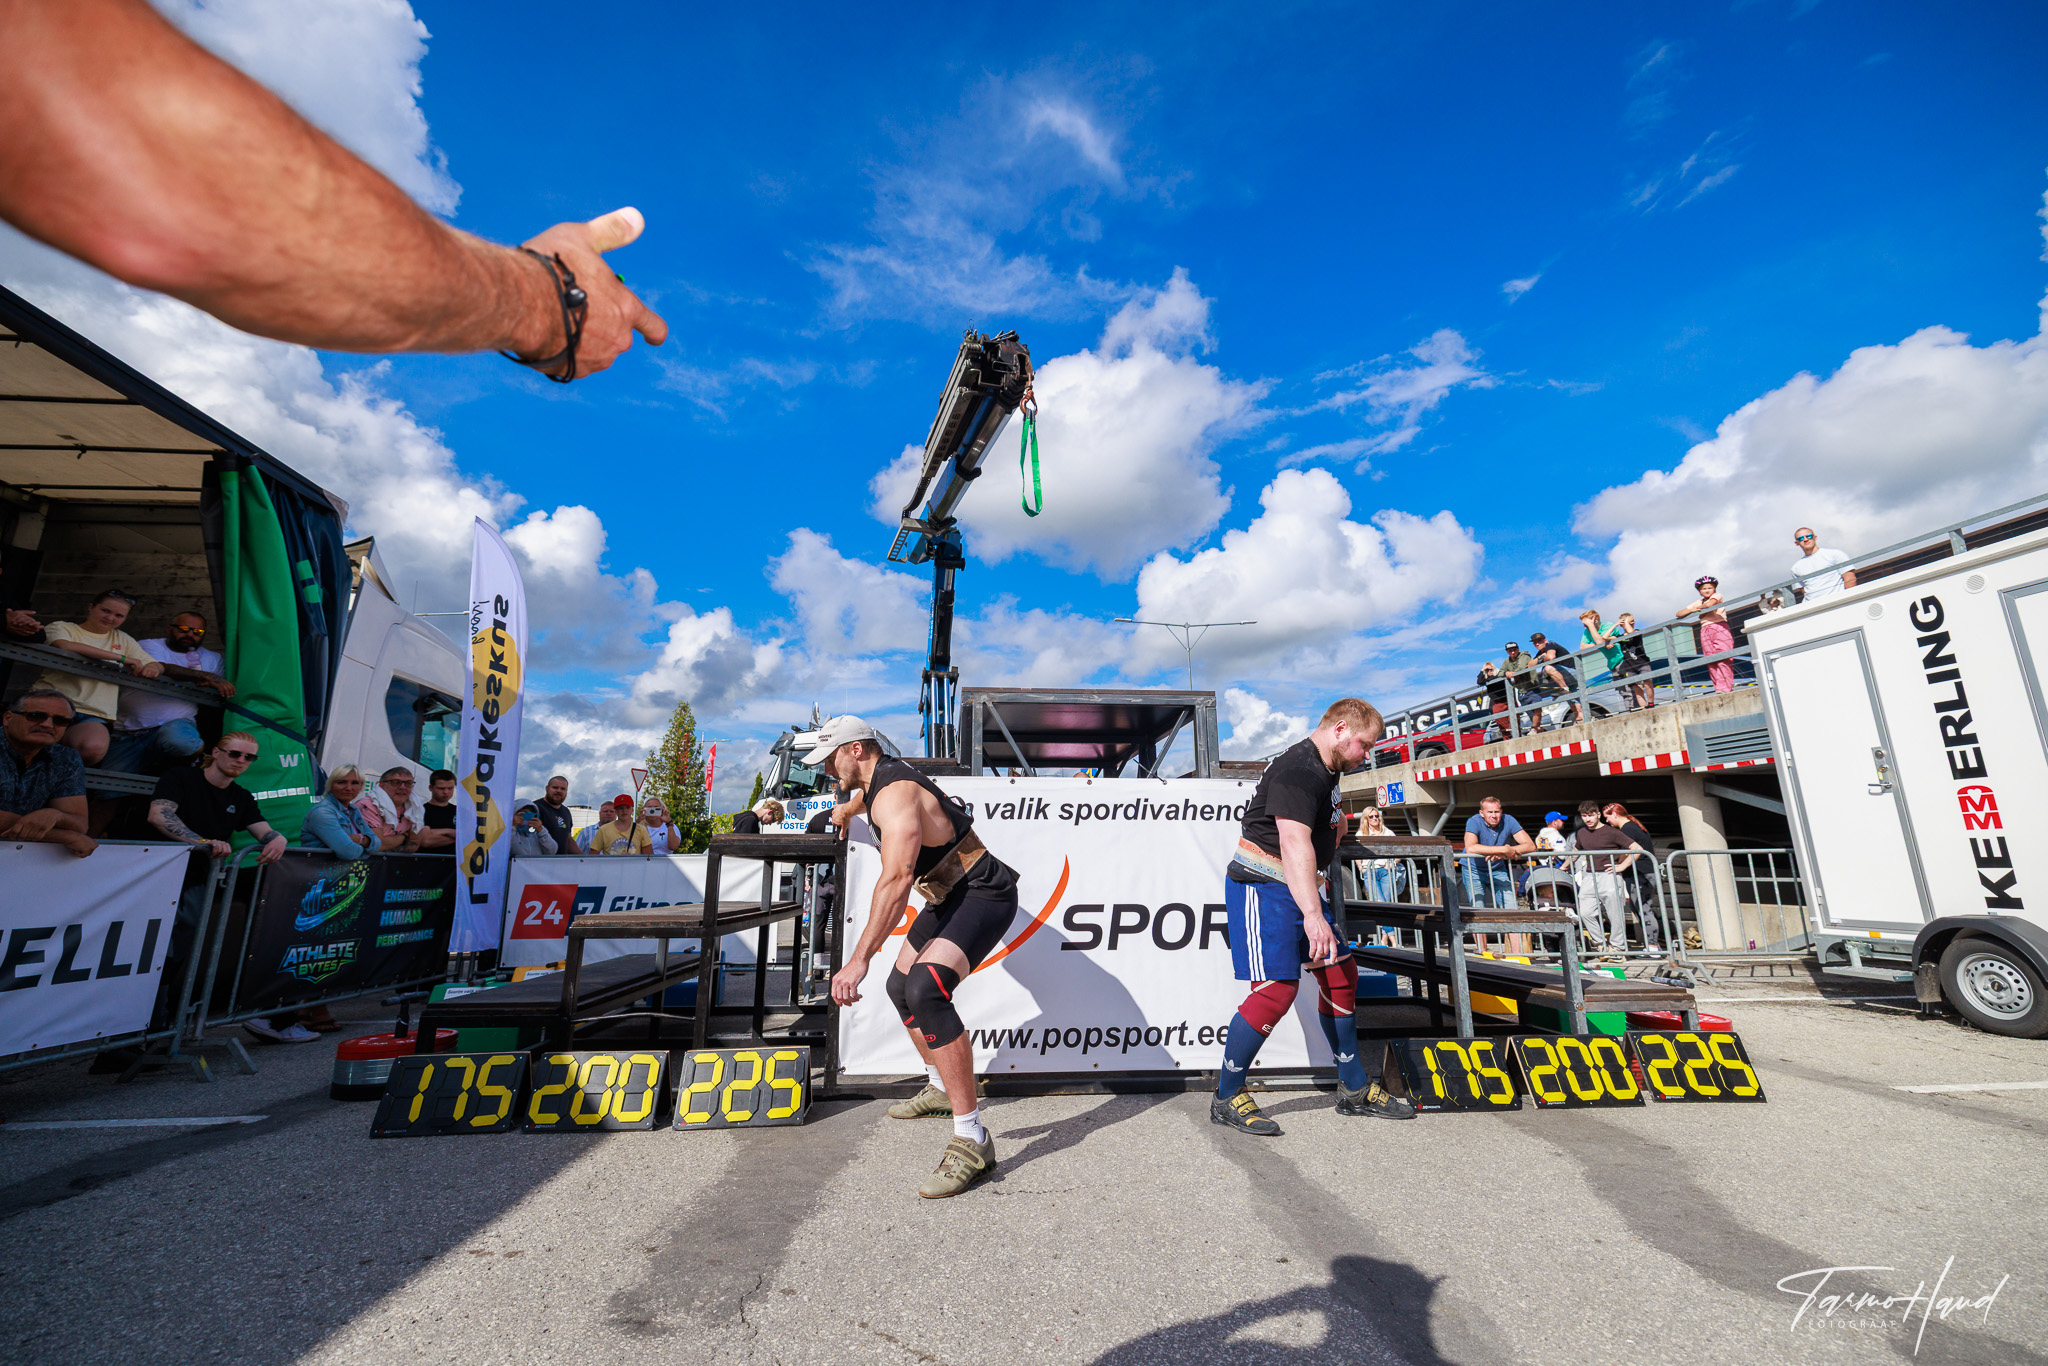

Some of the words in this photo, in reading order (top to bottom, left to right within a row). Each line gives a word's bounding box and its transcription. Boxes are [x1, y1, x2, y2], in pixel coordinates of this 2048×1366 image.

[985, 798, 1050, 820] valik
[379, 908, 422, 926] HUMAN
[384, 888, 443, 903] ENGINEERING
[523, 900, 563, 925] 24
[283, 942, 355, 967] ATHLETE
[1061, 902, 1231, 951] SPOR
[0, 918, 162, 992] ELLI
[298, 960, 339, 975] BYTES
[408, 1055, 516, 1127] 175
[528, 1054, 660, 1125] 200
[679, 1050, 802, 1124] 225
[1423, 1041, 1515, 1104] 175
[1523, 1038, 1639, 1101] 200
[1640, 1033, 1759, 1096] 225
